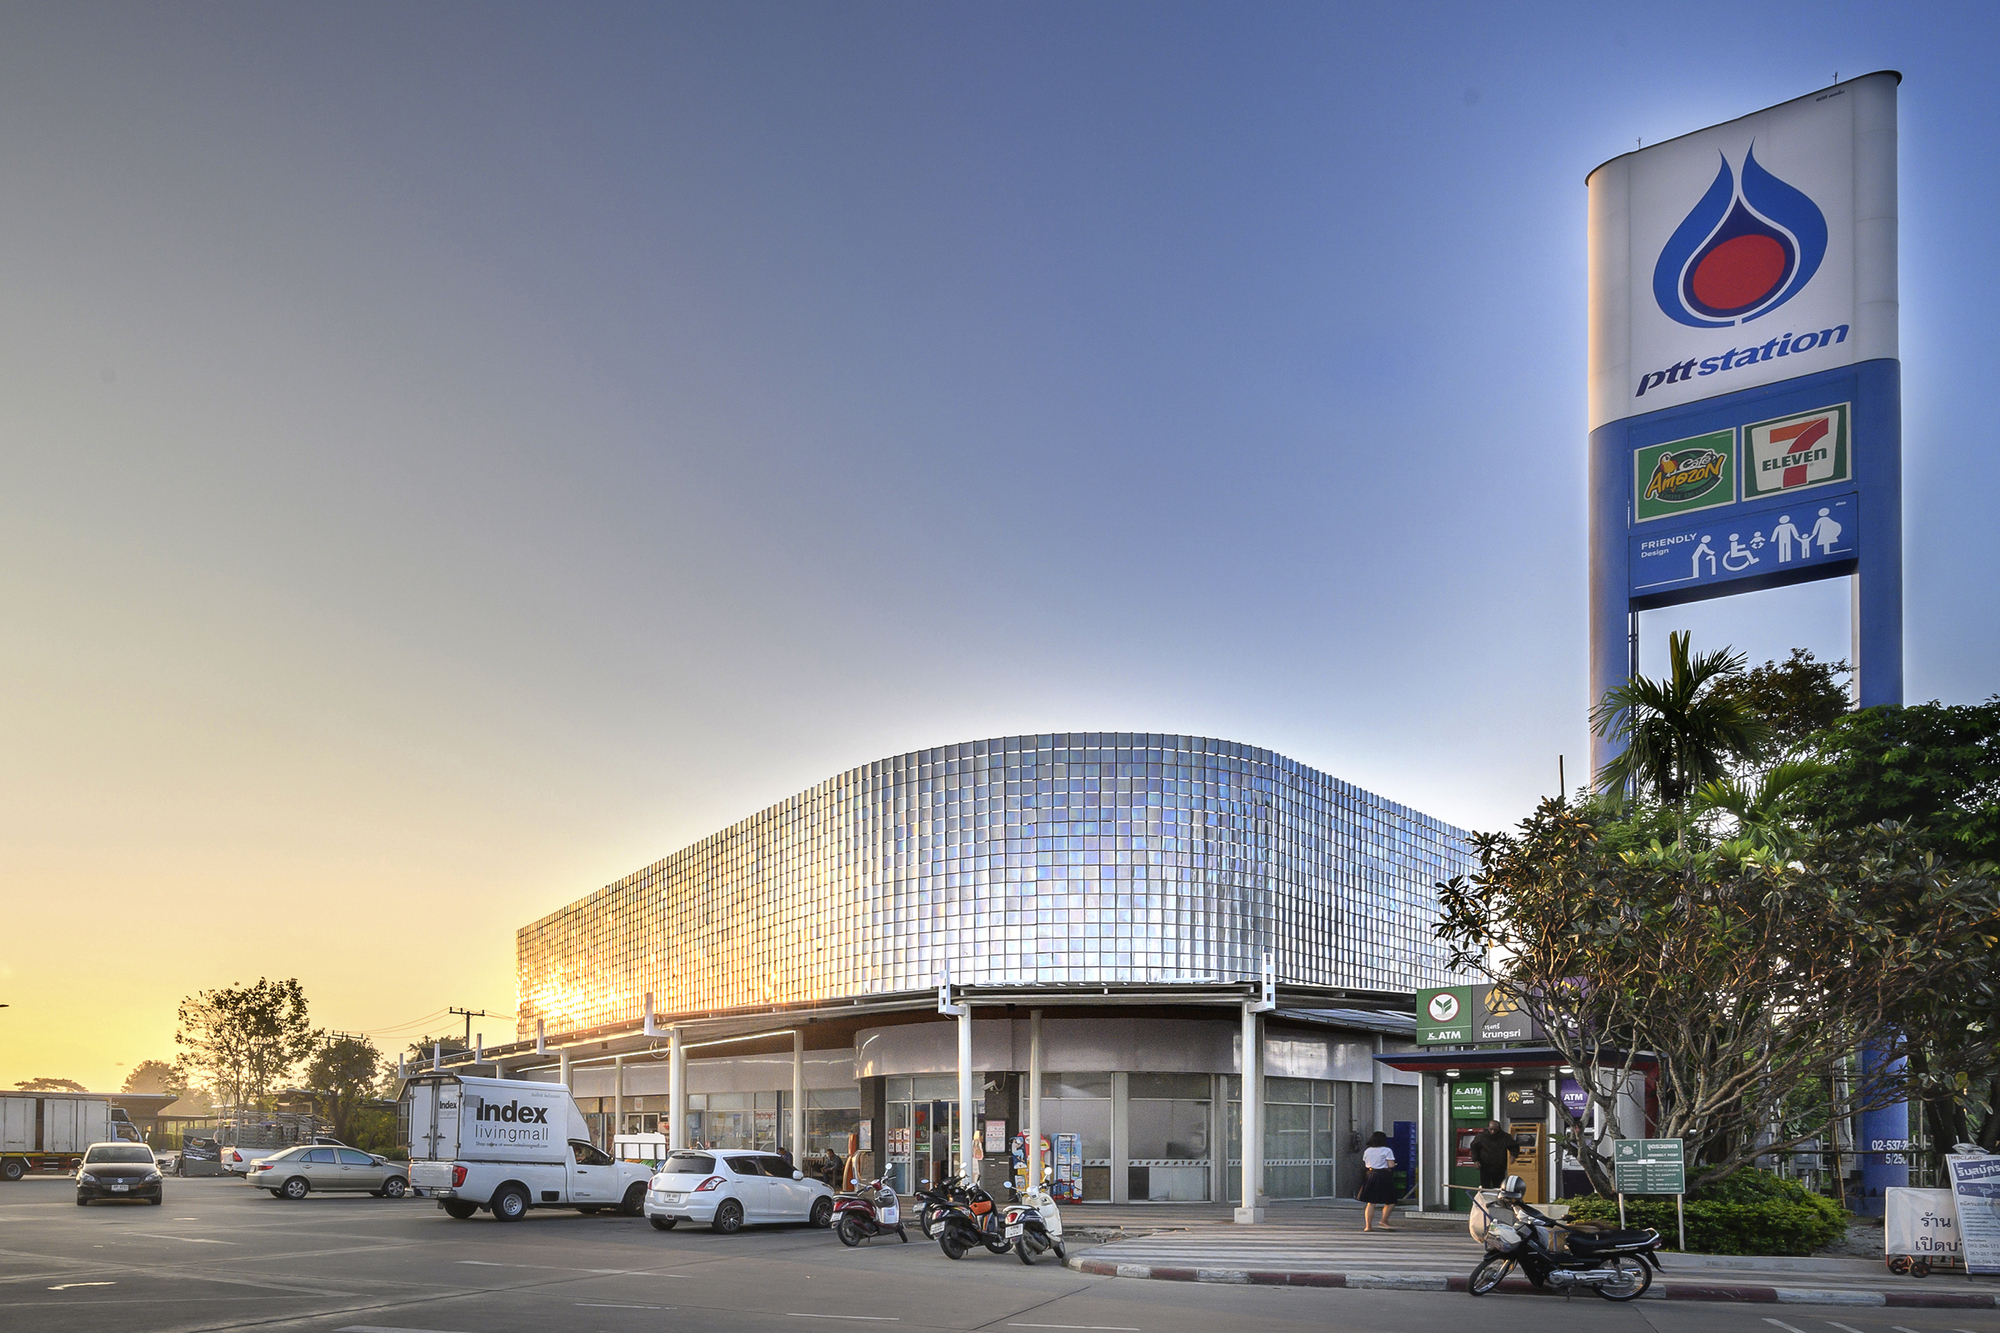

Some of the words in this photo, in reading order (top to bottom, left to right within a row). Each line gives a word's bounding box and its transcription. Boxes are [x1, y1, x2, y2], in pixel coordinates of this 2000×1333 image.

[1769, 417, 1829, 488] 7
[1641, 548, 1669, 558] Design
[1438, 1030, 1461, 1040] ATM
[1482, 1028, 1521, 1039] krungsri
[1564, 1093, 1583, 1101] ATM
[439, 1100, 457, 1109] Index
[476, 1097, 548, 1124] Index
[475, 1124, 548, 1142] livingmall
[1921, 1212, 1951, 1227] ร้าน
